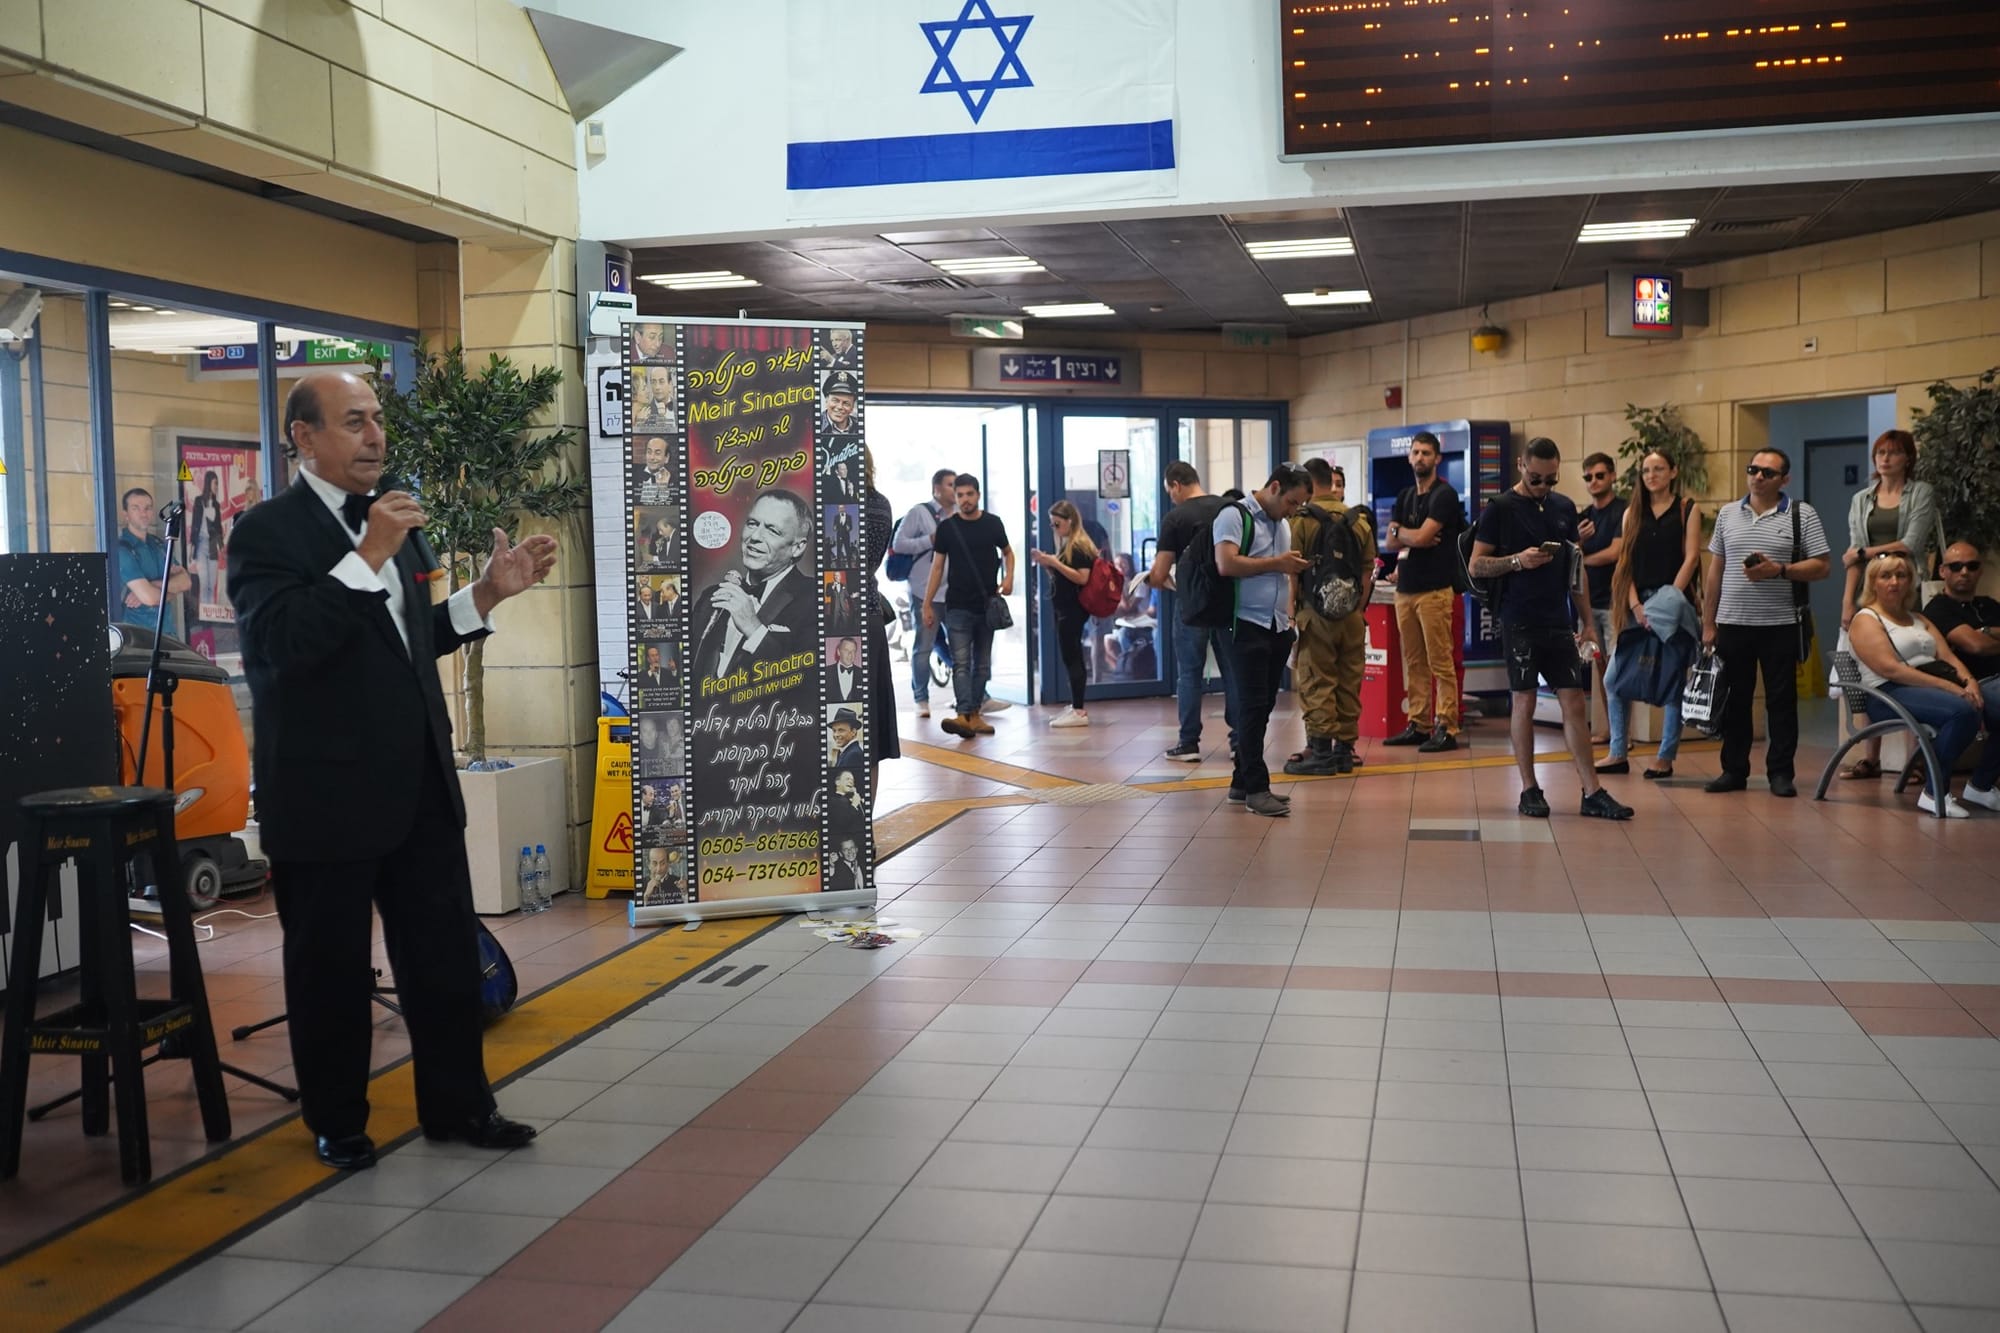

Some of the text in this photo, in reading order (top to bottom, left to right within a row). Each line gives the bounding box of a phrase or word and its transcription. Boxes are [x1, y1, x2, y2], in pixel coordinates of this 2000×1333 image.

[314, 348, 338, 359] EXIT
[687, 345, 814, 396] מאיר סינטרה
[1051, 356, 1097, 380] רציף 1
[688, 386, 815, 425] Meir Sinatra
[714, 414, 791, 454] שר ומבצע
[756, 451, 808, 489] פרנק
[820, 436, 859, 476] Sinatra
[694, 455, 755, 495] סינטרה
[702, 667, 748, 697] Frank
[753, 652, 815, 682] Sinatra
[737, 689, 753, 702] DID
[755, 685, 763, 697] IT
[765, 683, 780, 694] MY
[781, 674, 803, 689] WAY
[691, 701, 814, 740] בביצוע להיטים גדולים
[710, 744, 769, 772] התקופות
[772, 730, 795, 762] מכל
[610, 761, 632, 769] CAUTI
[729, 761, 791, 802] זהה למקור
[698, 788, 822, 833] בליווי מוסיקה מקורית
[701, 830, 818, 856] 0505-867566
[702, 860, 818, 885] 054-7376502
[31, 1034, 100, 1050] Meir Sinatra
[145, 1013, 192, 1041] Meir Sinatra
